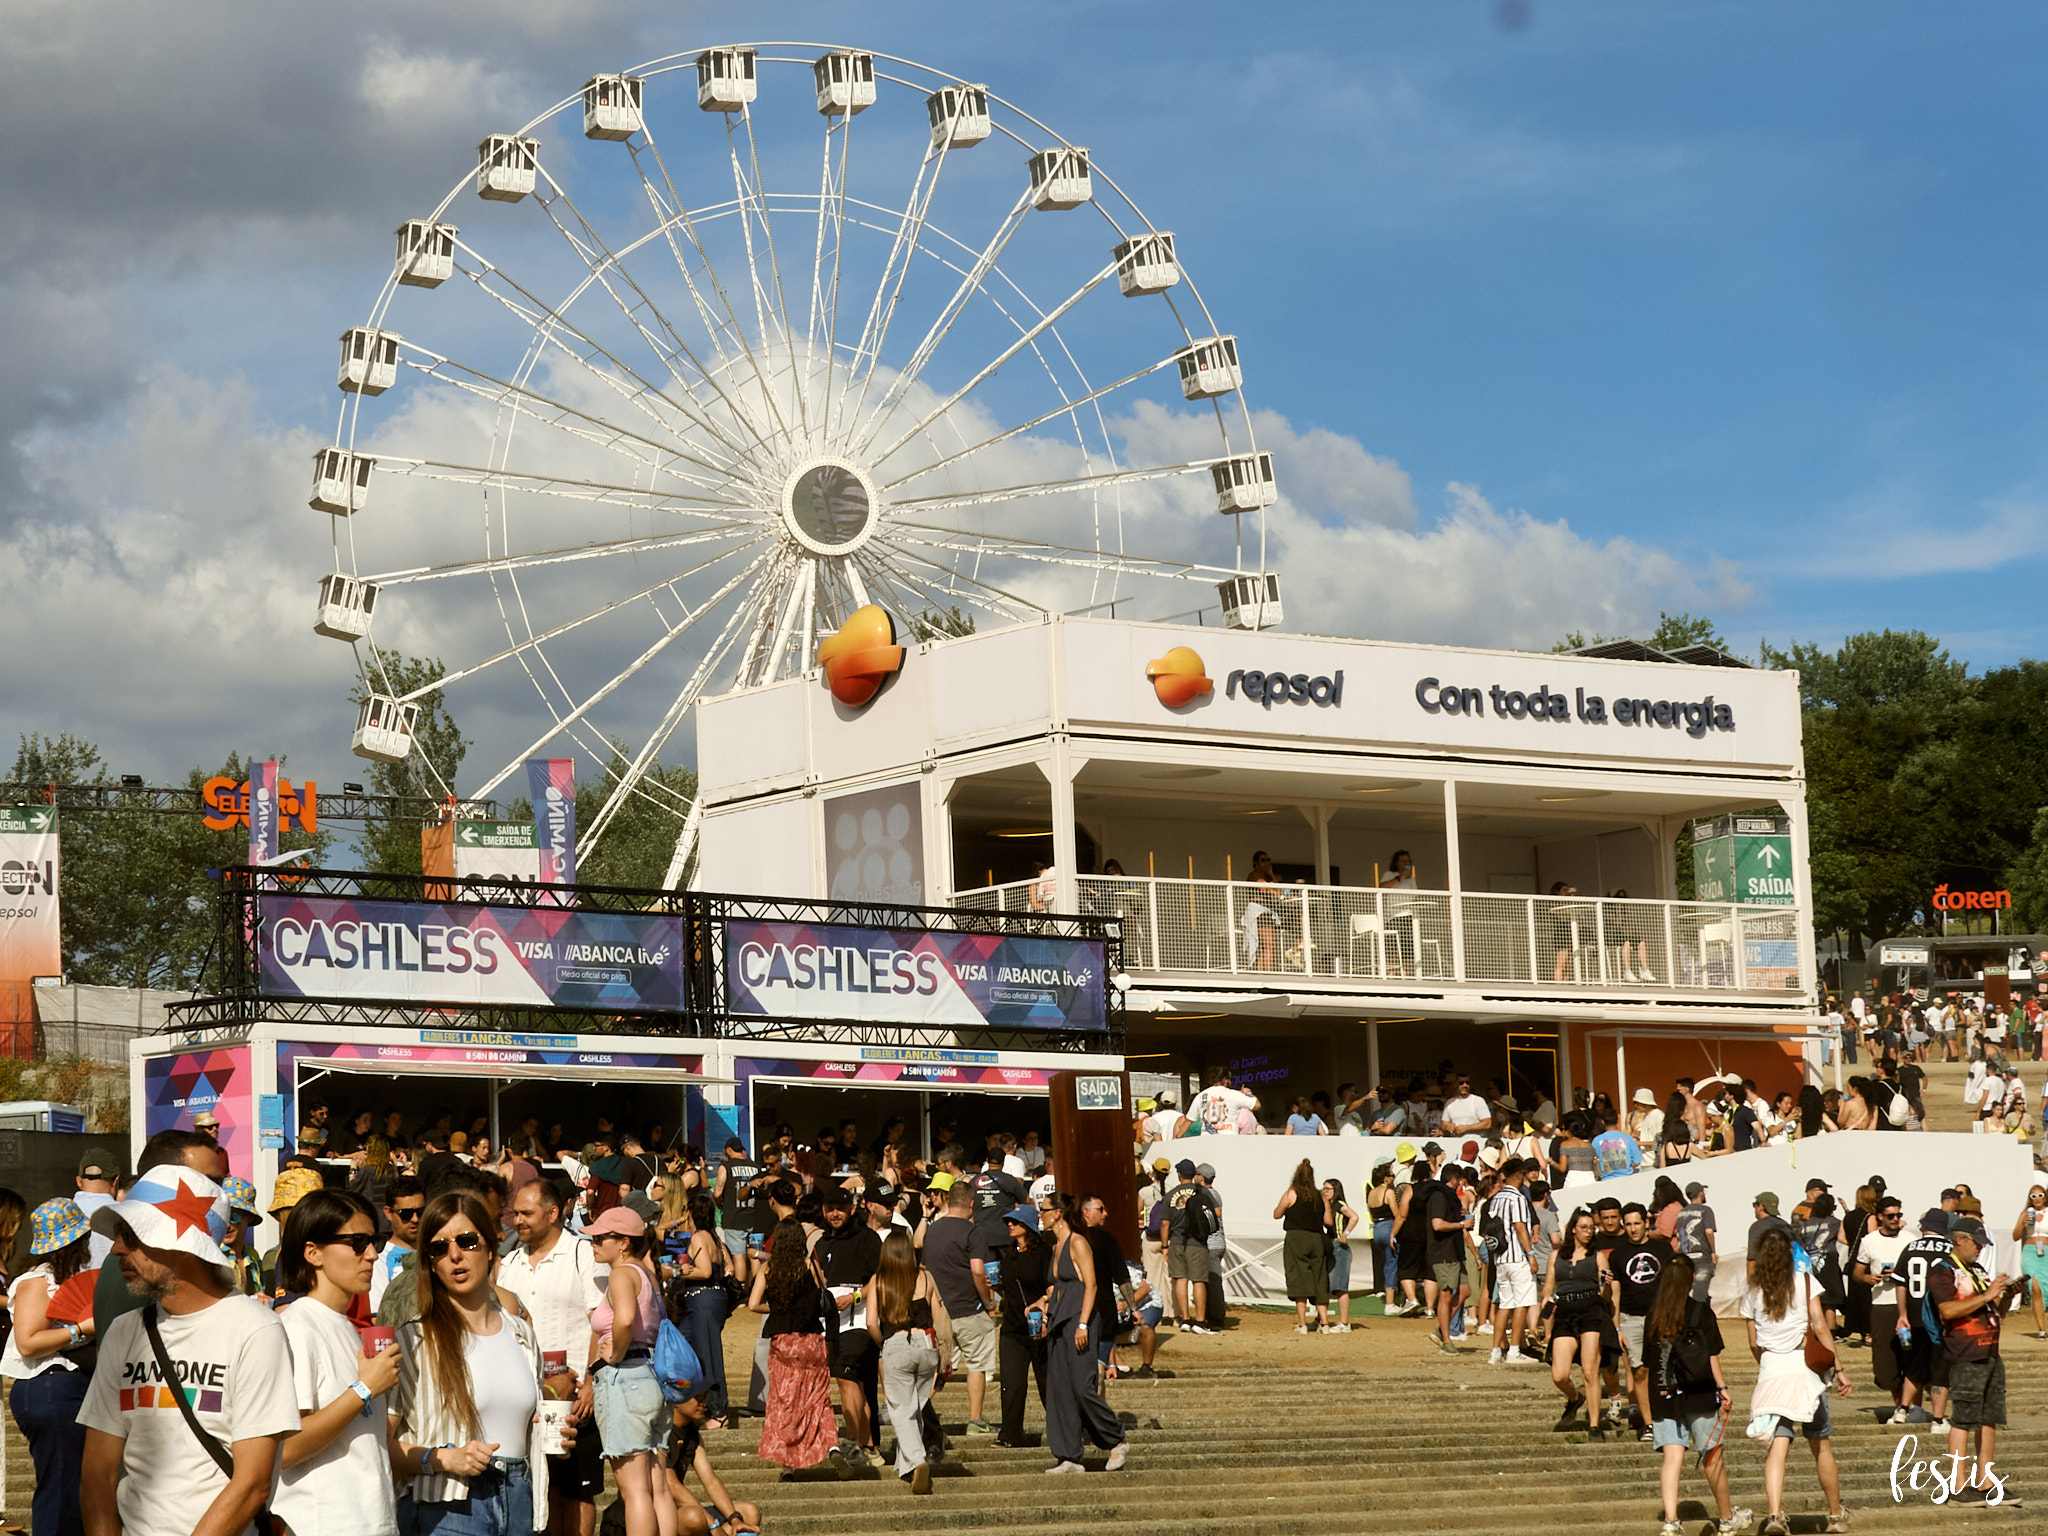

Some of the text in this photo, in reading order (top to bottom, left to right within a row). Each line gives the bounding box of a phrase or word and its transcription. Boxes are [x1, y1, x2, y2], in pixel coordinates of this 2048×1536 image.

[1226, 669, 1343, 707] repsol
[1416, 677, 1735, 735] Con toda la energía
[496, 824, 531, 835] SAÍDA DE
[483, 836, 532, 846] EMERXENCIA
[1748, 874, 1794, 895] SAÍDA
[274, 919, 498, 975] CASHLESS
[515, 942, 553, 959] VISA
[638, 947, 664, 965] live
[740, 942, 938, 996] CASHLESS
[954, 965, 987, 981] VISA
[1063, 970, 1087, 986] live
[462, 1033, 512, 1045] LANCAS
[378, 1047, 413, 1057] CASHLESS
[473, 1052, 488, 1061] SON
[500, 1051, 527, 1062] CAMIÑO
[579, 1055, 612, 1063] CASHLESS
[1242, 1056, 1268, 1068] barra
[825, 1062, 856, 1072] CASHLESS
[1003, 1069, 1032, 1078] CASHLESS
[1256, 1066, 1288, 1082] repsol
[1908, 1240, 1954, 1253] BEAST
[122, 1360, 226, 1387] PANONE
